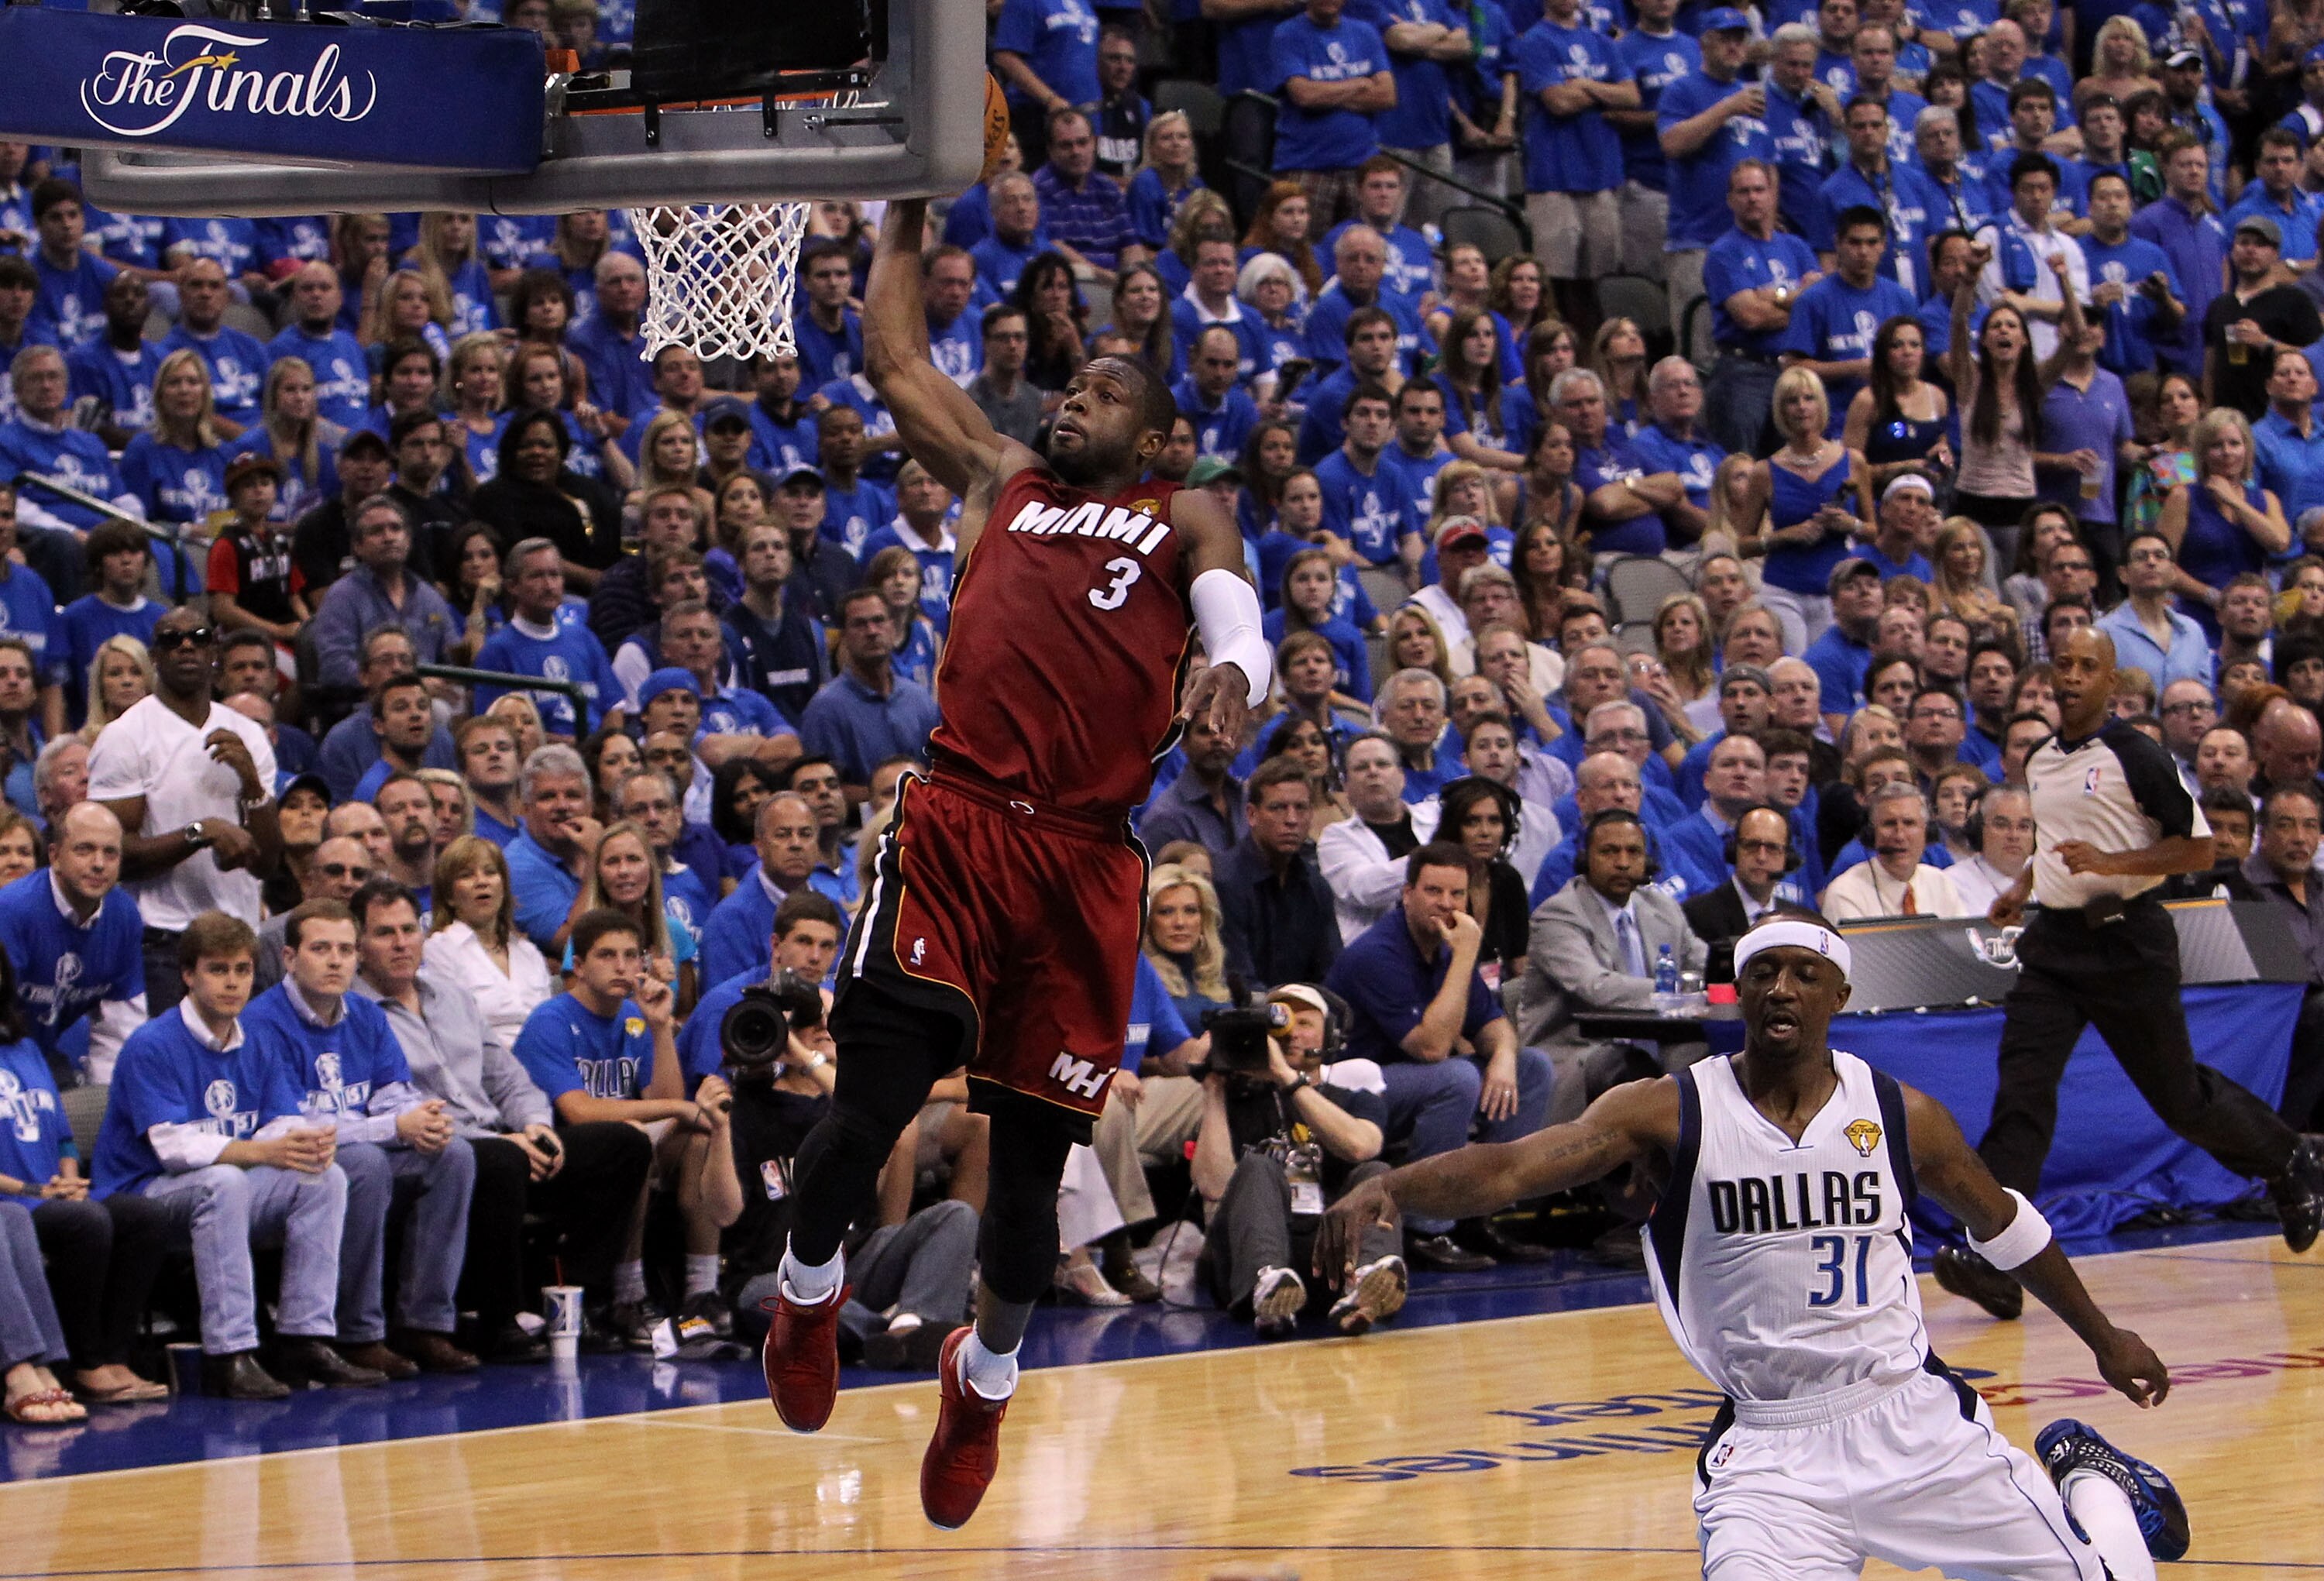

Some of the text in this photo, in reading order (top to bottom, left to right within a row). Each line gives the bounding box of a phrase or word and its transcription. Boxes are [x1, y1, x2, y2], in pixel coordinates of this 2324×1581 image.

[81, 24, 376, 136] The Finals
[1007, 500, 1171, 556] MIAMI
[1088, 556, 1142, 611] 3
[1707, 1170, 1881, 1234] DALLAS
[1807, 1235, 1875, 1309] 31
